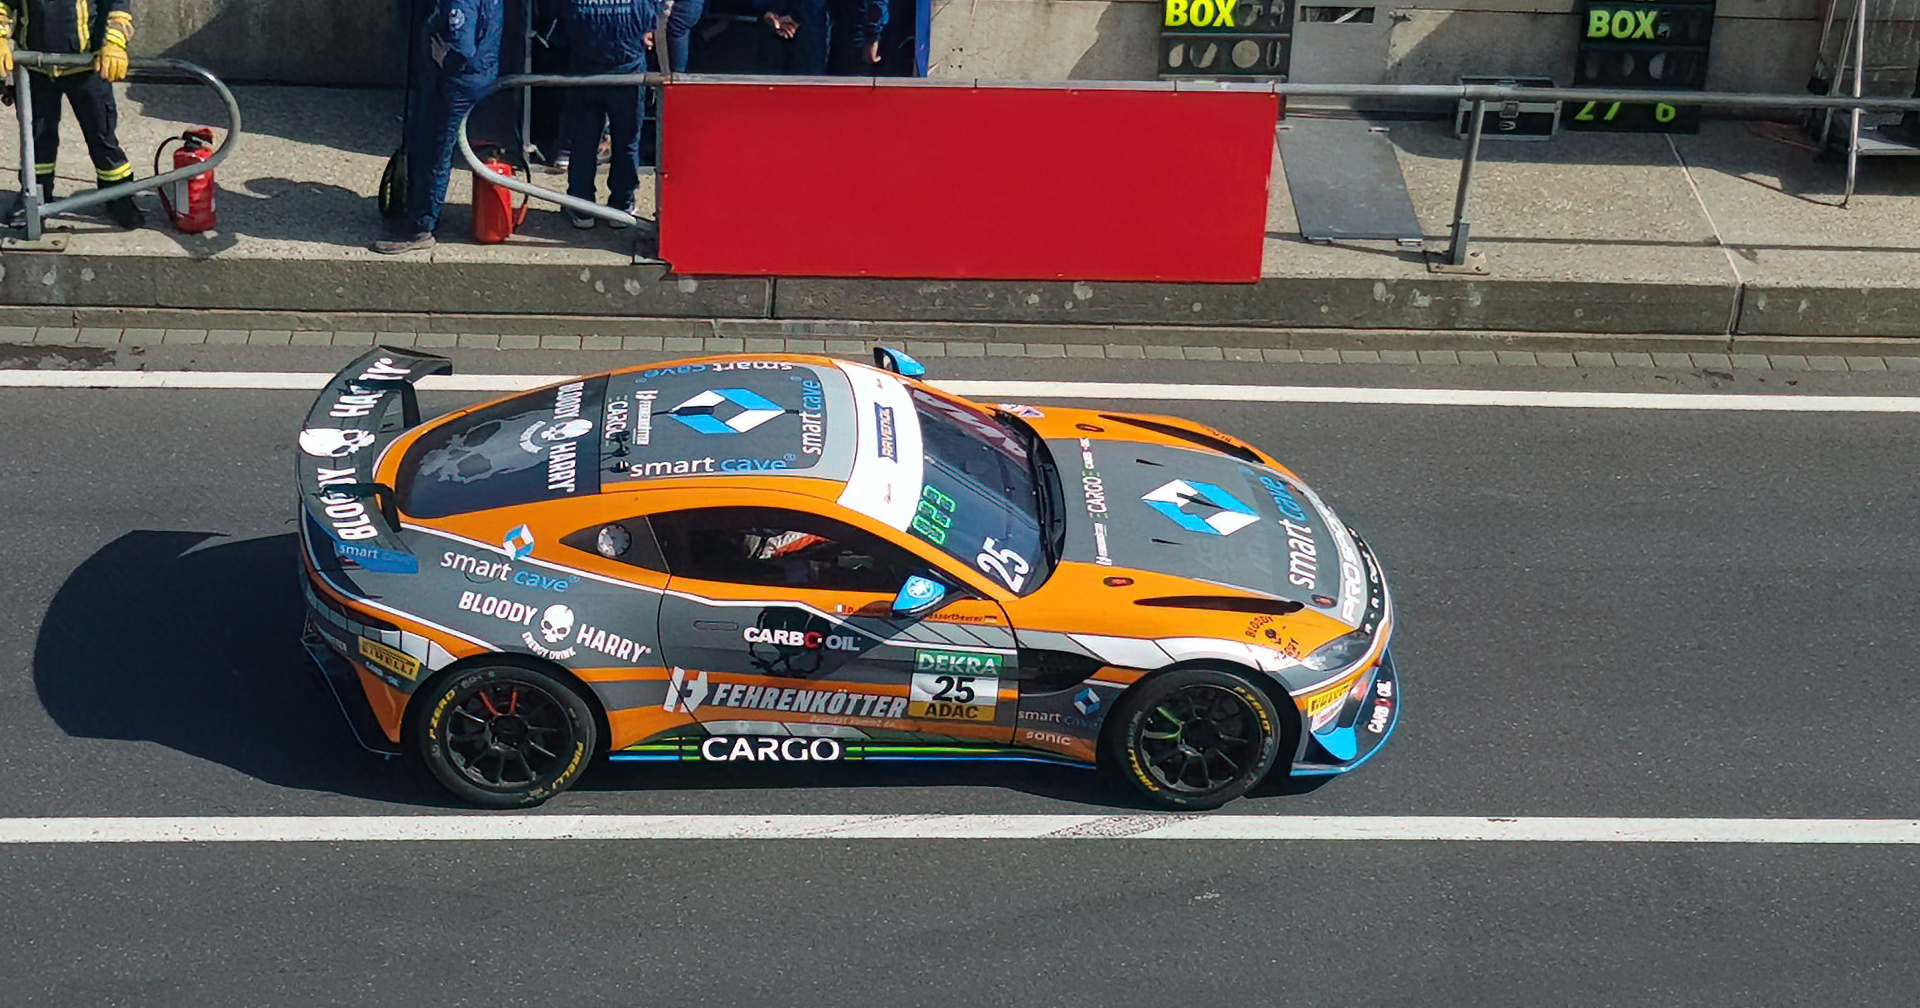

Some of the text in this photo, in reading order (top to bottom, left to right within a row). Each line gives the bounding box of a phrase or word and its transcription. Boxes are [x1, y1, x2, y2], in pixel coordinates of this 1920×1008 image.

[1165, 0, 1236, 27] BOX
[1587, 10, 1658, 39] BOX
[712, 361, 792, 371] smart
[799, 379, 821, 455] smart cave
[548, 382, 584, 492] BLOODY HARRY
[630, 457, 788, 477] smart cave
[1082, 476, 1107, 513] CARGO
[1260, 476, 1317, 590] smart cave
[339, 543, 379, 559] smart
[977, 537, 1029, 592] 25
[440, 551, 569, 593] smart cave
[458, 591, 647, 663] BLOODY HARRY
[826, 635, 860, 651] OIL
[919, 653, 997, 676] DEKRA
[711, 683, 908, 718] FEHRENKÖTTER
[932, 676, 977, 703] 25
[925, 703, 979, 719] ADAC
[1018, 710, 1063, 724] smart
[702, 737, 841, 762] CARGO
[1026, 731, 1071, 746] sonic
